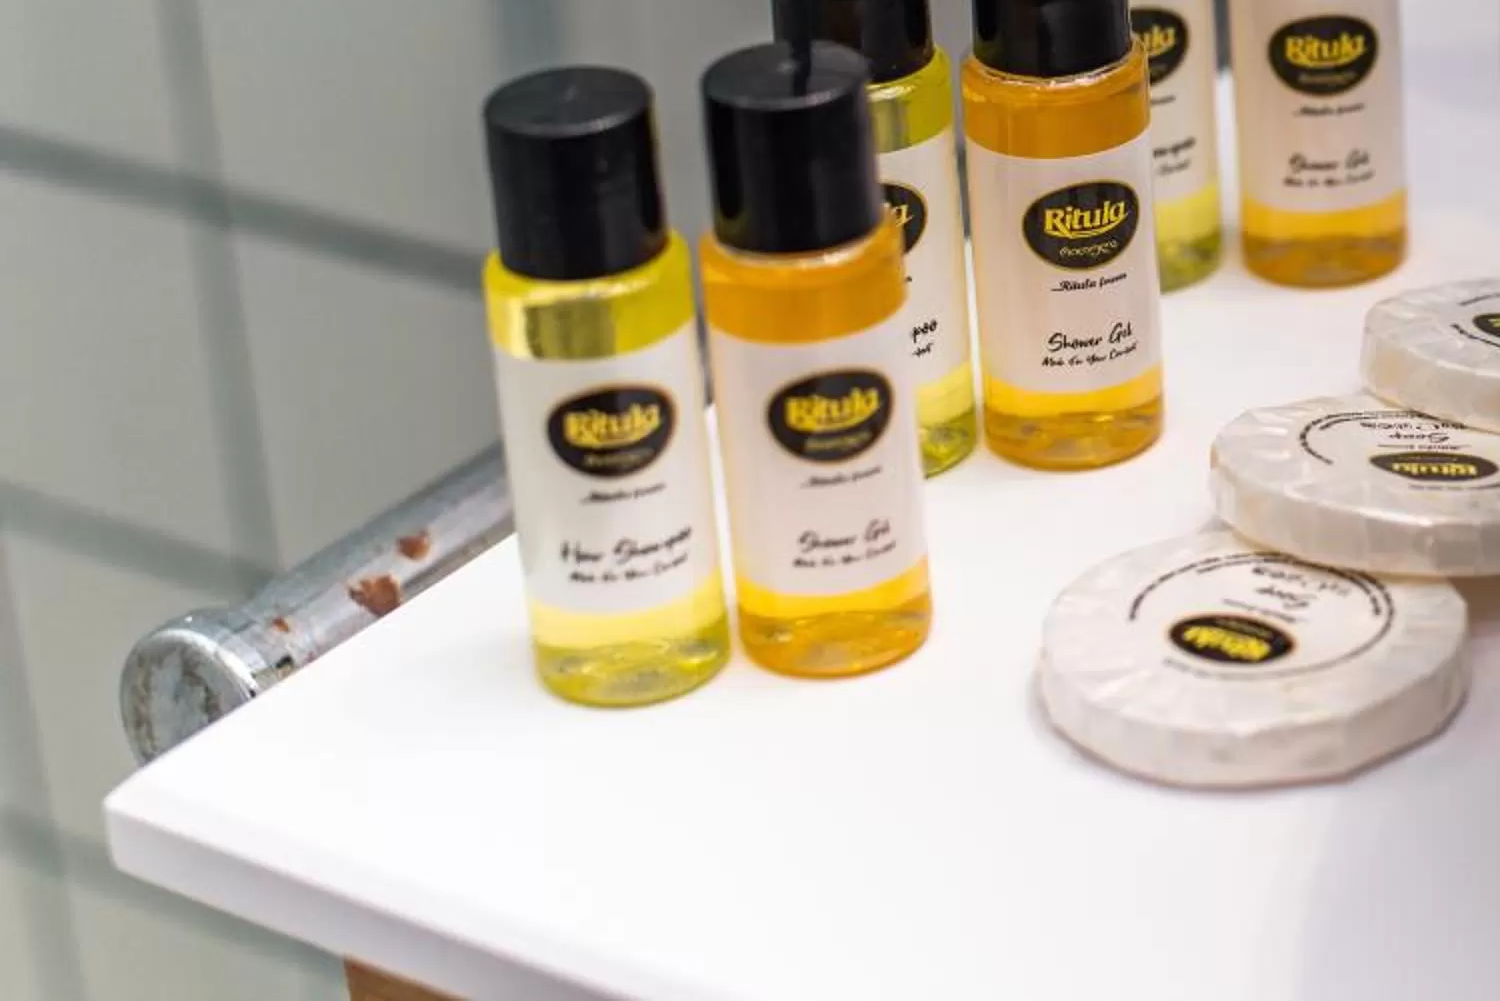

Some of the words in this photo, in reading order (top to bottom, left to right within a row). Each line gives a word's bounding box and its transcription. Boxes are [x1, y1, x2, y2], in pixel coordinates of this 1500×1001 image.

[1044, 200, 1129, 239] Ritula
[1048, 332, 1103, 353] Shower
[1108, 320, 1132, 344] Gel
